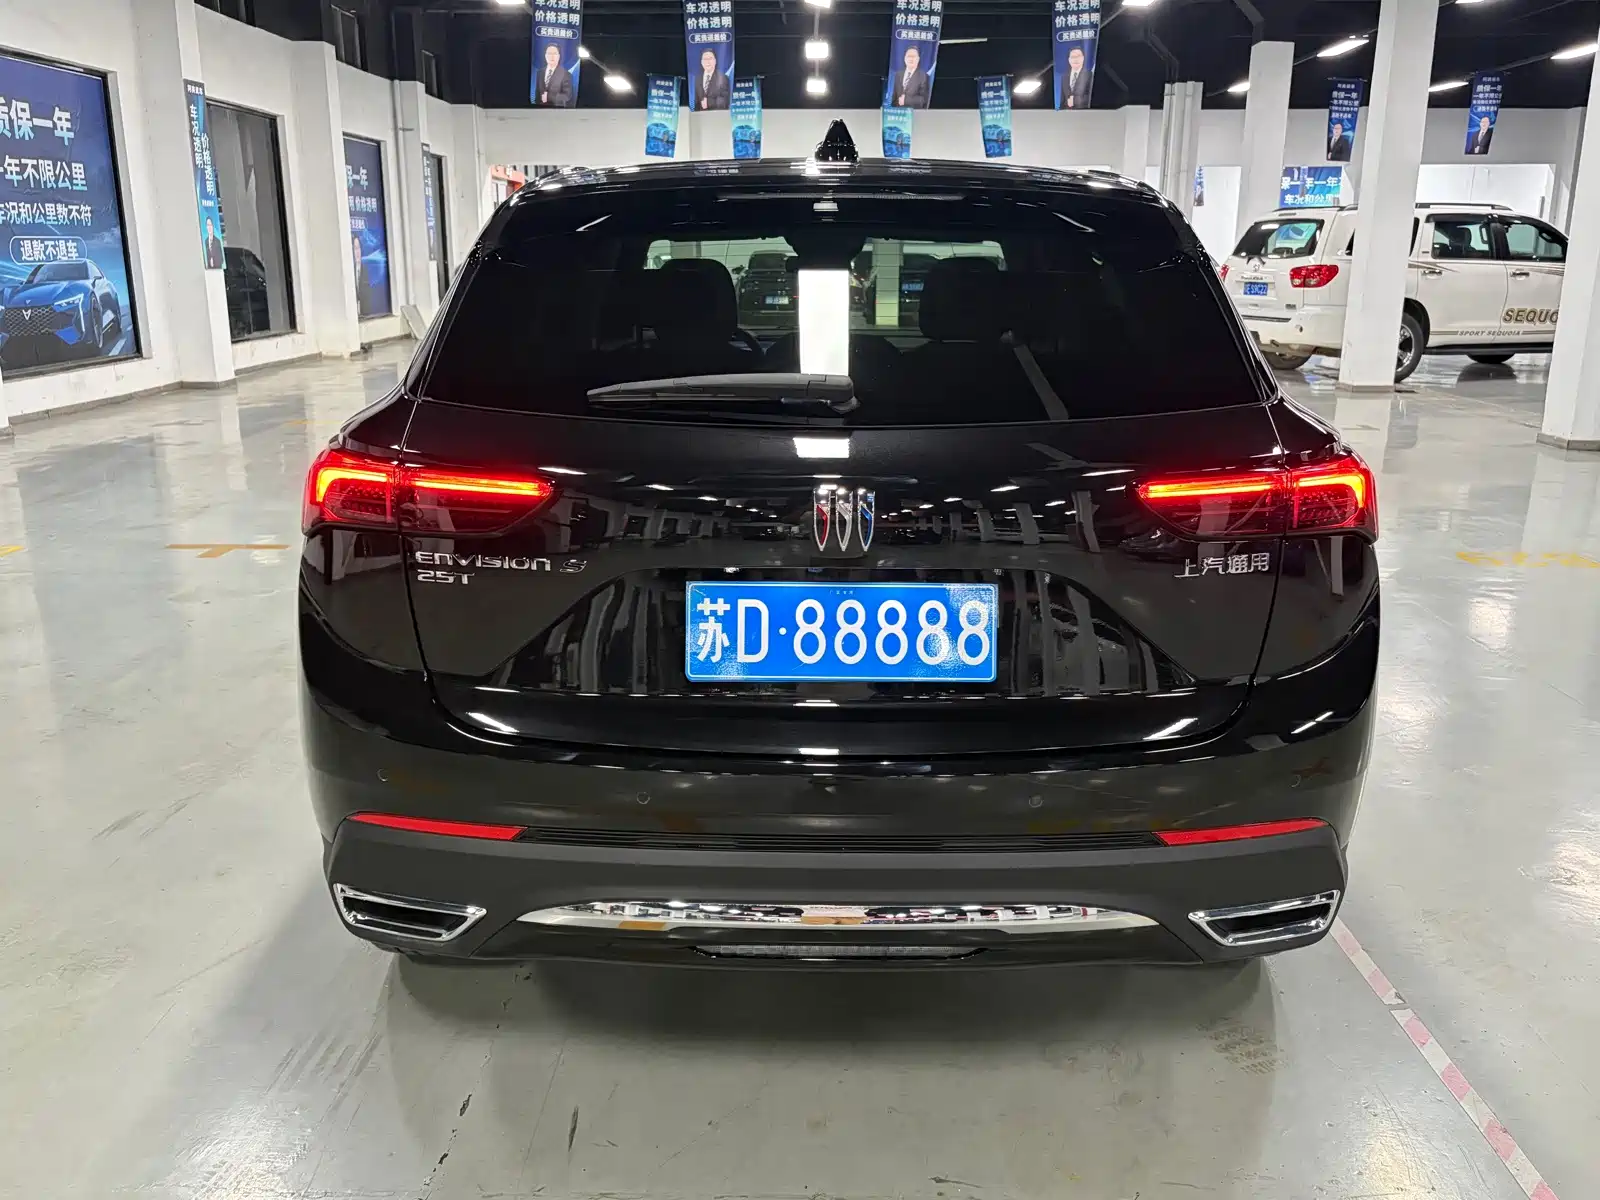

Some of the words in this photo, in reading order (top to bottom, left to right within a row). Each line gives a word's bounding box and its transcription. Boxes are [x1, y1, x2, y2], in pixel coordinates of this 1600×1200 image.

[686, 1, 732, 14] 车况透明
[897, 0, 942, 12] 车况透明
[1055, 0, 1100, 12] 车况透明
[535, 10, 580, 26] 价格透明
[687, 16, 732, 30] 价格透明
[895, 13, 941, 28] 价格透明
[1055, 12, 1100, 28] 价格透明
[190, 104, 204, 168] 车况透明
[201, 132, 215, 196] 价格透明
[0, 154, 88, 191] 年不限公里
[20, 239, 79, 262] 退款不退车
[560, 558, 588, 574] S
[1174, 552, 1270, 578] 上汽通用
[417, 569, 475, 585] 25T
